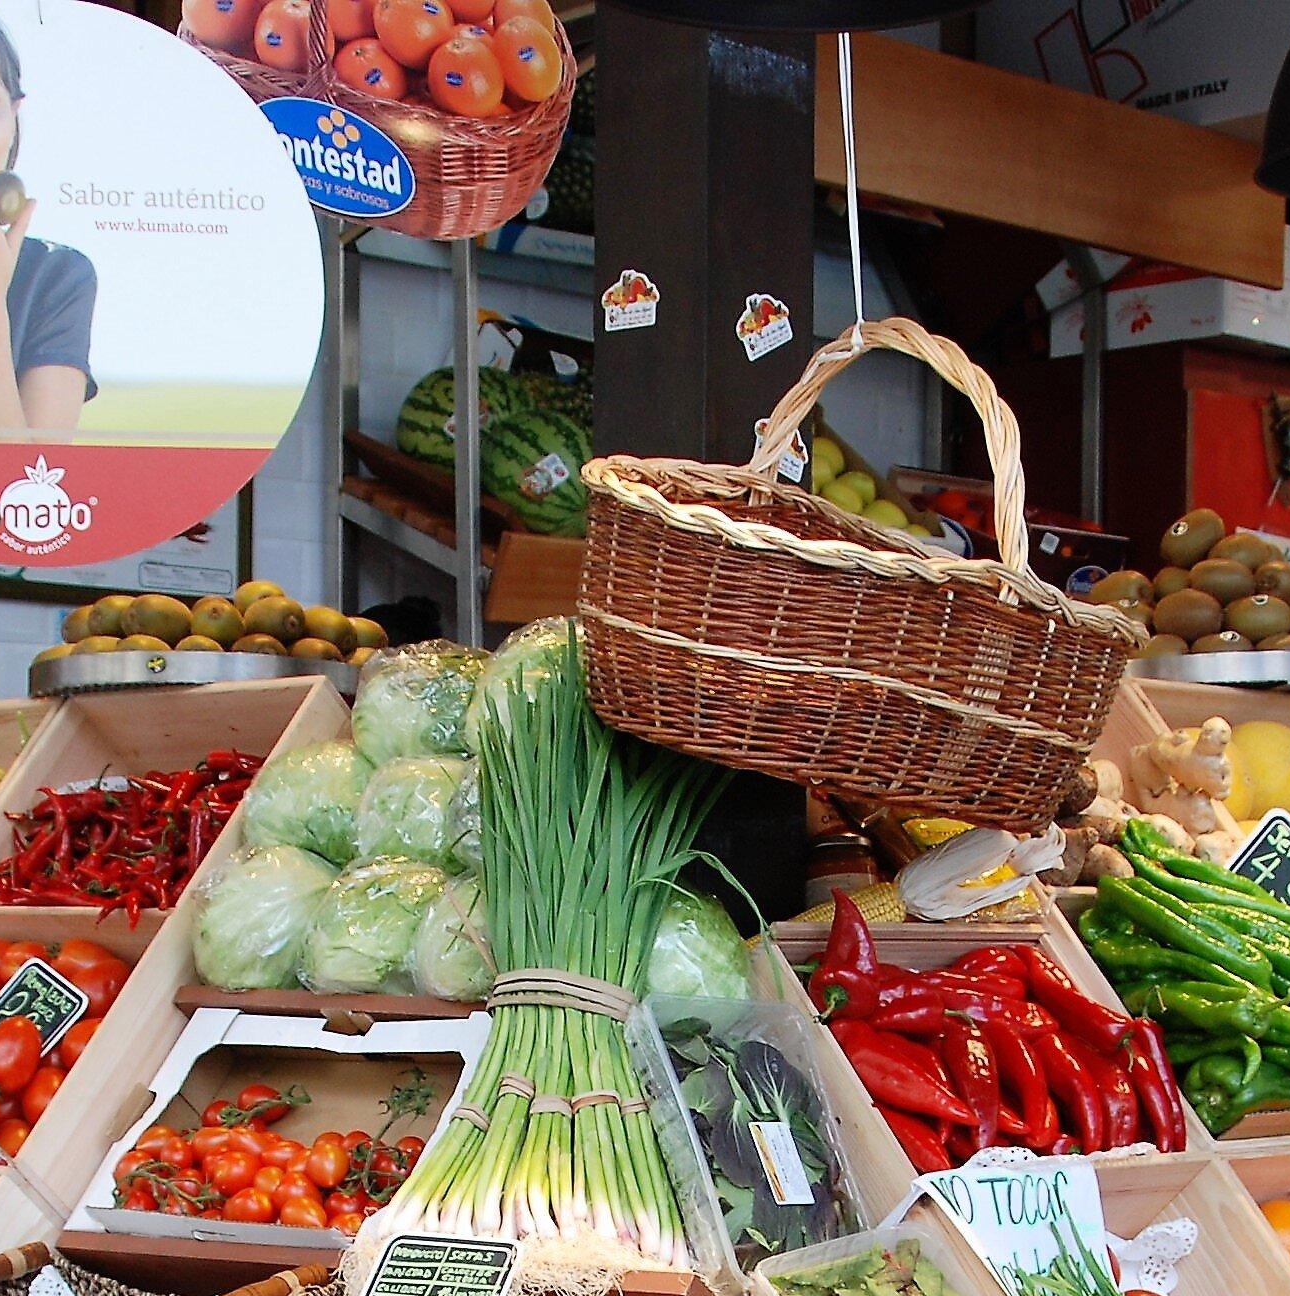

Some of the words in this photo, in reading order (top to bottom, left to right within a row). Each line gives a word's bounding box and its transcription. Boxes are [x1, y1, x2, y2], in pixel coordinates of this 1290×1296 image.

[1175, 89, 1191, 104] IN
[1192, 77, 1230, 98] ITALY
[58, 181, 135, 208] Sabor
[143, 186, 266, 212] auténtico
[94, 218, 229, 235] www.kumato.com
